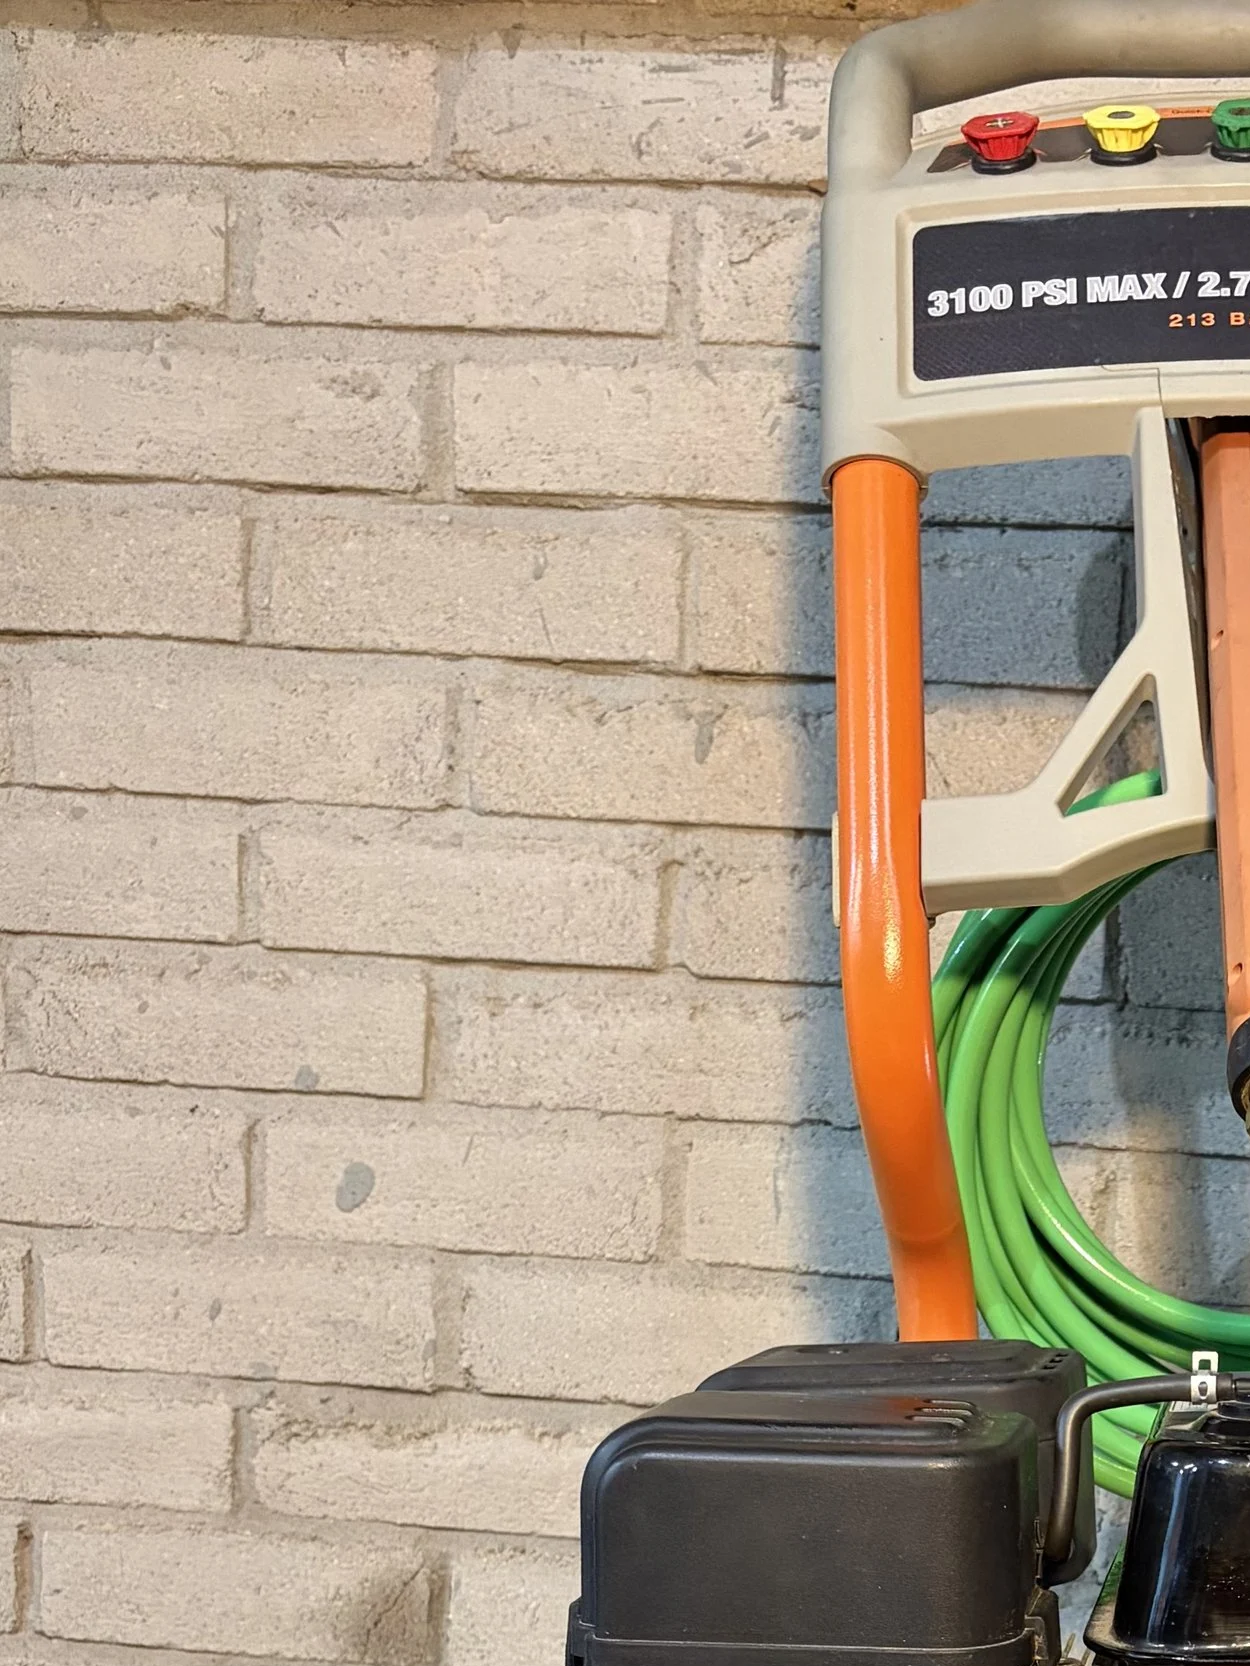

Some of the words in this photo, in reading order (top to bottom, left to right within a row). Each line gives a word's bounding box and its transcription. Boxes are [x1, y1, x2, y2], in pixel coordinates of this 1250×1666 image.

[927, 283, 1013, 317] 3100
[1021, 277, 1077, 308] PSI
[1086, 272, 1168, 303] MAX
[1172, 271, 1191, 299] /
[1168, 312, 1216, 329] 213
